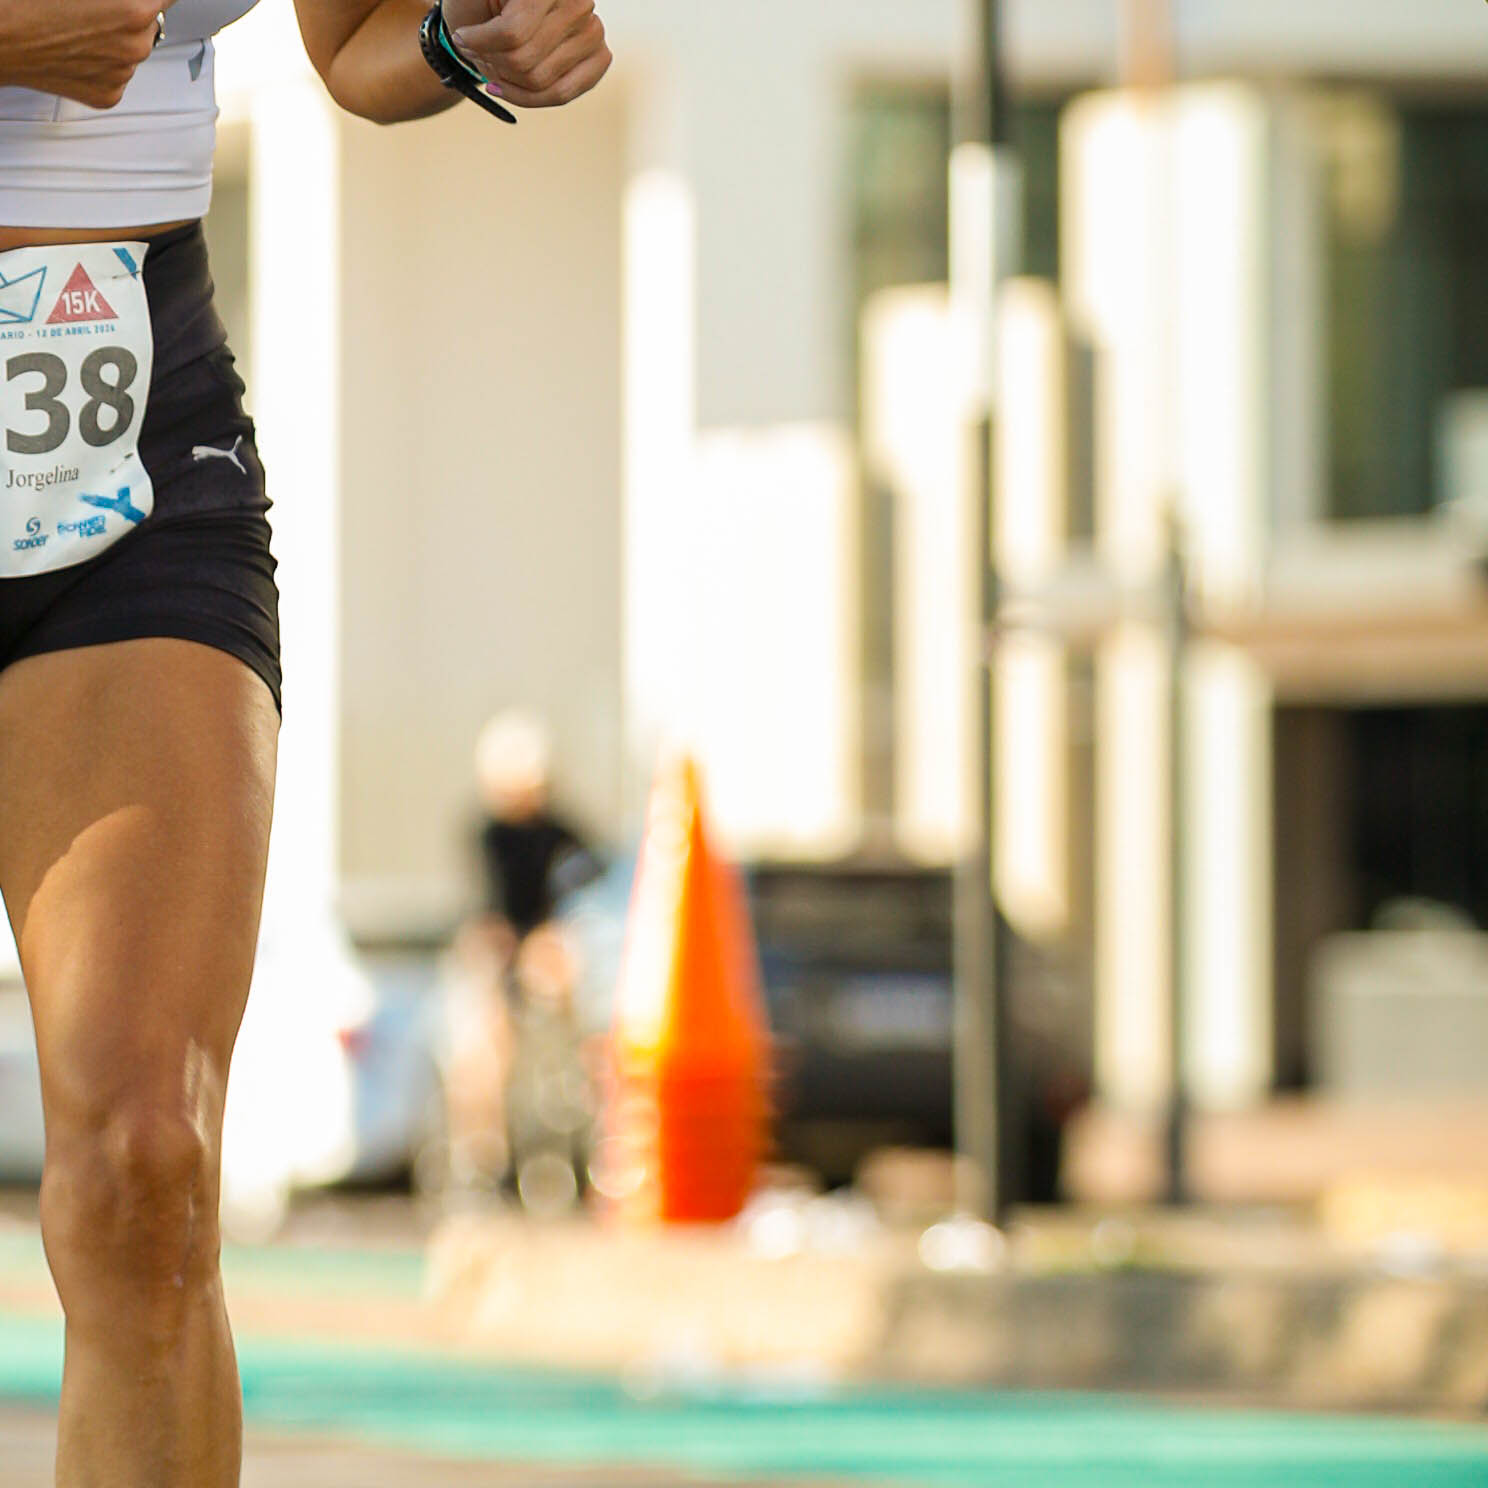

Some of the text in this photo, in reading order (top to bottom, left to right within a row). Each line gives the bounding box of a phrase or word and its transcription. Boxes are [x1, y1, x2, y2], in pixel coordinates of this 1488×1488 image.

[61, 290, 102, 315] 15K
[50, 327, 62, 337] DE
[64, 326, 92, 336] ABRIL
[6, 465, 80, 491] Jorgelina
